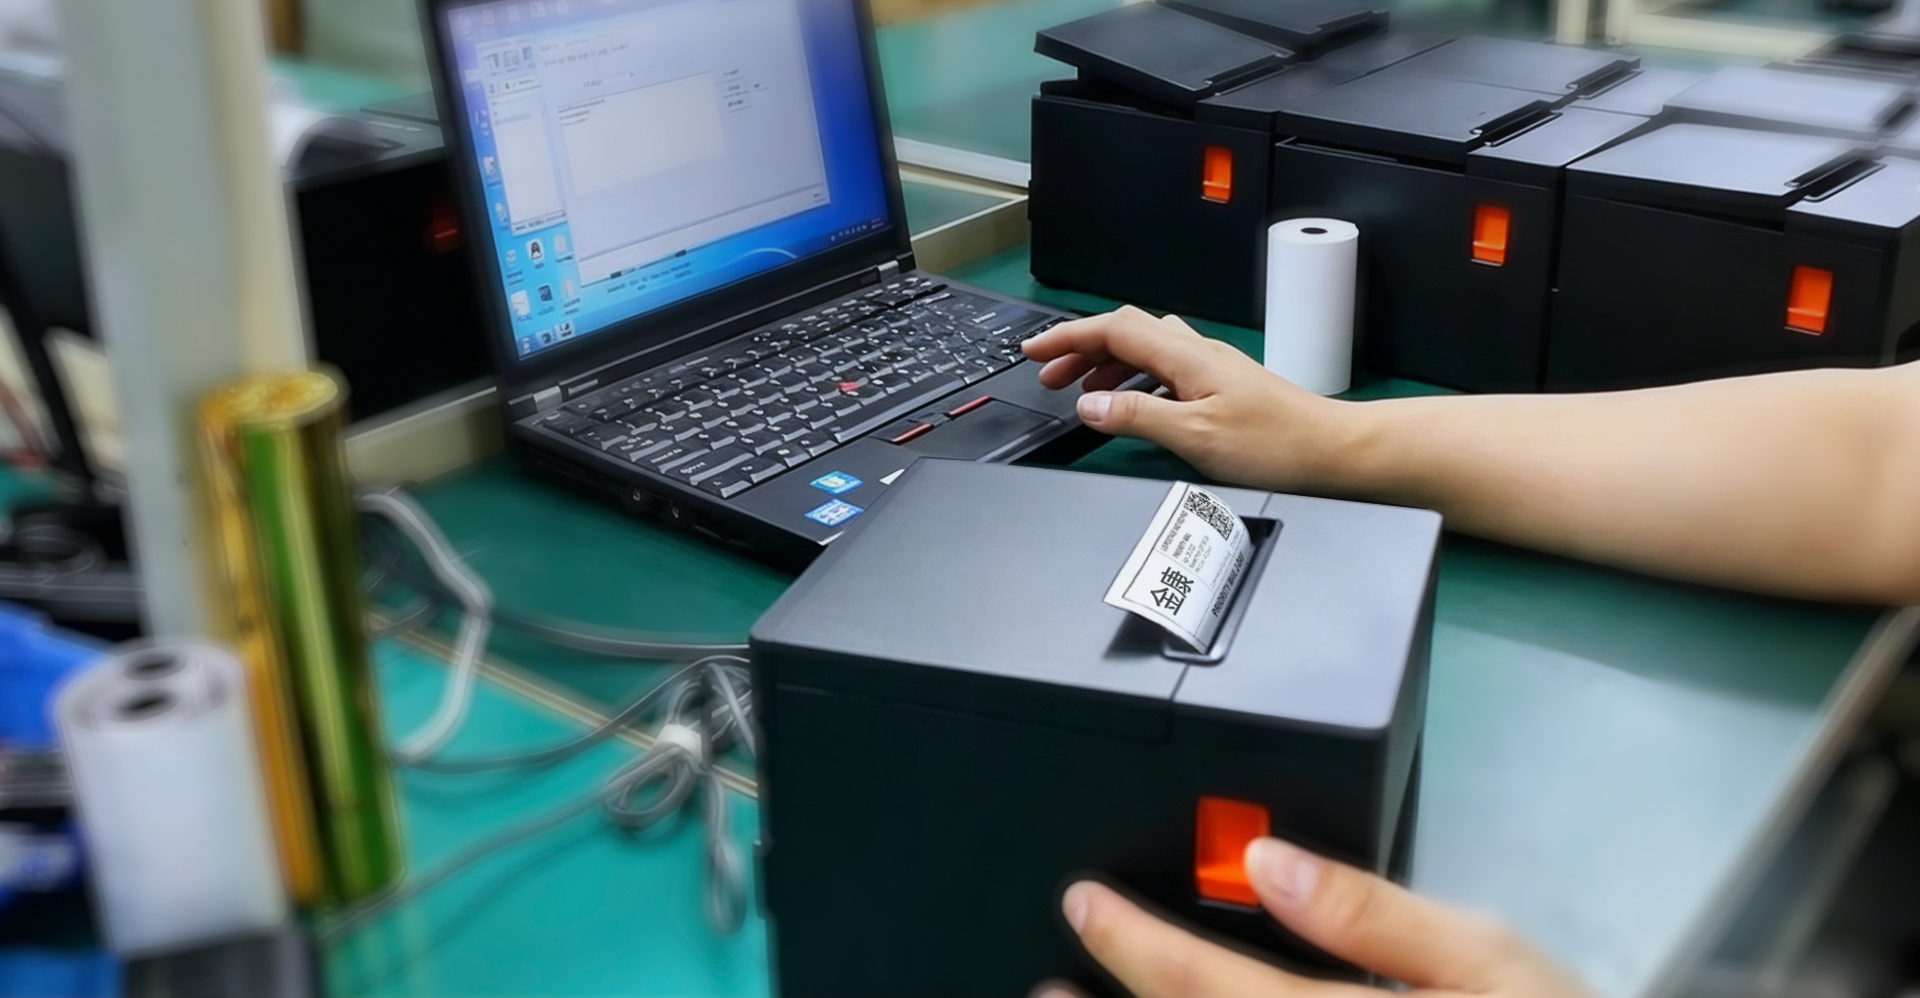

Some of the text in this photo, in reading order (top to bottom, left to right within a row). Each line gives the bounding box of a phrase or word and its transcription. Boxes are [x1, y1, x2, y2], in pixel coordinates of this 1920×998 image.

[1150, 566, 1195, 616] 金康
[1212, 582, 1231, 617] PRIORITY
[1227, 568, 1238, 587] MAIL
